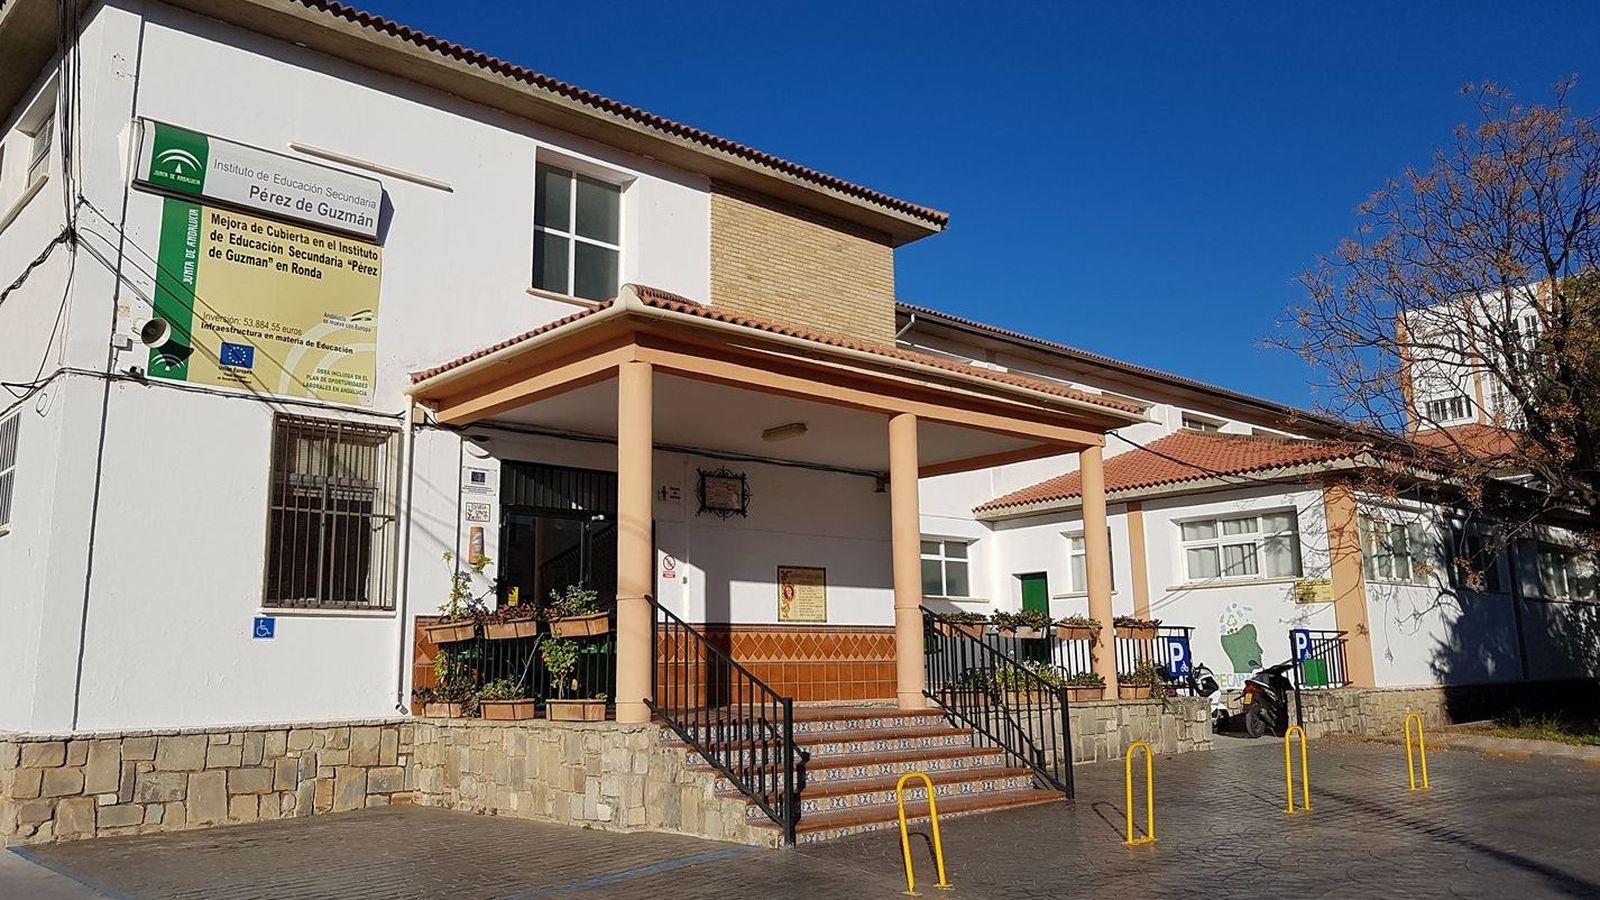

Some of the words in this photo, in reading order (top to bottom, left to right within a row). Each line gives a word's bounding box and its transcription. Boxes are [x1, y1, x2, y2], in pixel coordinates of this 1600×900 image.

[169, 173, 175, 181] DE
[214, 159, 253, 178] Instituto
[257, 170, 269, 181] de
[273, 173, 322, 194] Educación
[325, 187, 376, 209] Secundaria
[249, 185, 291, 208] Pérez
[295, 198, 313, 212] de
[317, 202, 373, 227] Guzmán
[210, 229, 223, 242] de
[229, 233, 284, 254] Educación
[288, 246, 343, 268] Secundaria
[211, 213, 247, 230] Mejora
[250, 222, 263, 234] de
[266, 226, 309, 244] Cubierta
[312, 238, 324, 248] en
[327, 240, 336, 250] el
[339, 241, 378, 260] Instituto
[185, 248, 196, 259] DE
[209, 246, 222, 259] de
[276, 262, 288, 272] en
[291, 262, 322, 279] Ronda
[182, 261, 195, 284] JUNTA
[203, 311, 241, 325] Inversión:
[243, 317, 280, 332] 53.884,55
[281, 325, 302, 336] euros
[355, 324, 371, 333] Europa
[201, 322, 262, 337] Infraestructura
[275, 334, 304, 345] materia
[305, 339, 314, 347] de
[316, 341, 353, 354] Educación
[302, 381, 331, 391] LABORALES
[328, 377, 368, 388] OPORTUNIDADES
[331, 370, 353, 378] INCLUIDA
[1169, 642, 1184, 673] P
[1295, 632, 1308, 660] P
